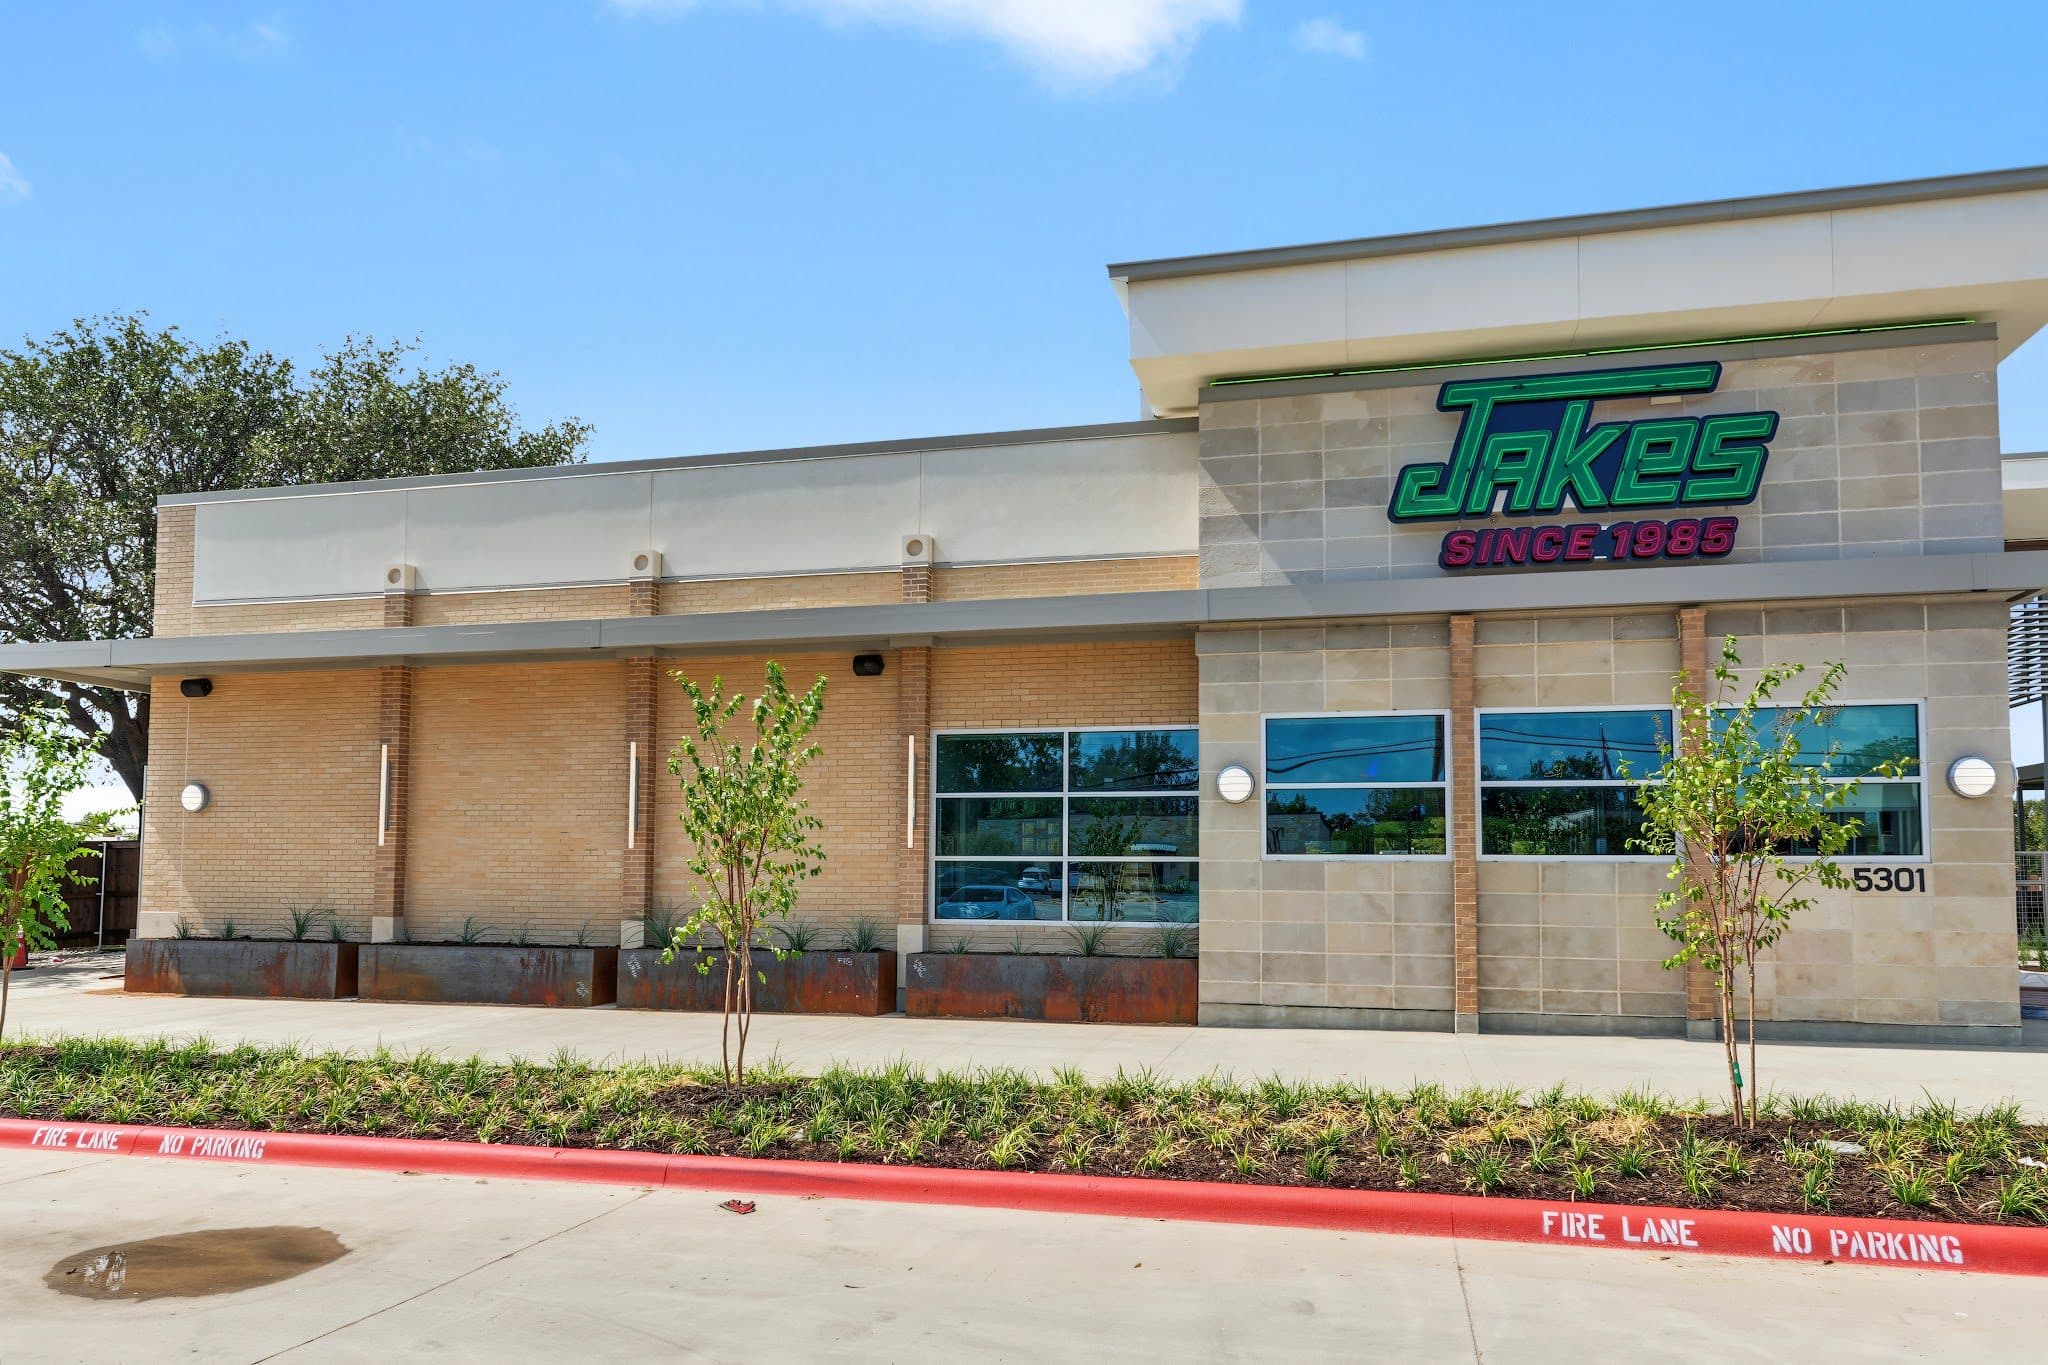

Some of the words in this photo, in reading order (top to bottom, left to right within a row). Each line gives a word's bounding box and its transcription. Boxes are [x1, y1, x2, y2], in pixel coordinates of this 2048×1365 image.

[1443, 523, 1600, 567] SINCE
[1612, 517, 1738, 560] 1985
[1854, 867, 1925, 892] 5301
[32, 1126, 73, 1147] FIRE
[76, 1128, 123, 1150] LANE
[159, 1133, 185, 1154] NO
[190, 1136, 265, 1158] PARKING
[1542, 1210, 1606, 1241] FIRE
[1622, 1215, 1698, 1247] LANE
[1771, 1224, 1812, 1254] NO
[1829, 1228, 1963, 1264] PARKING
